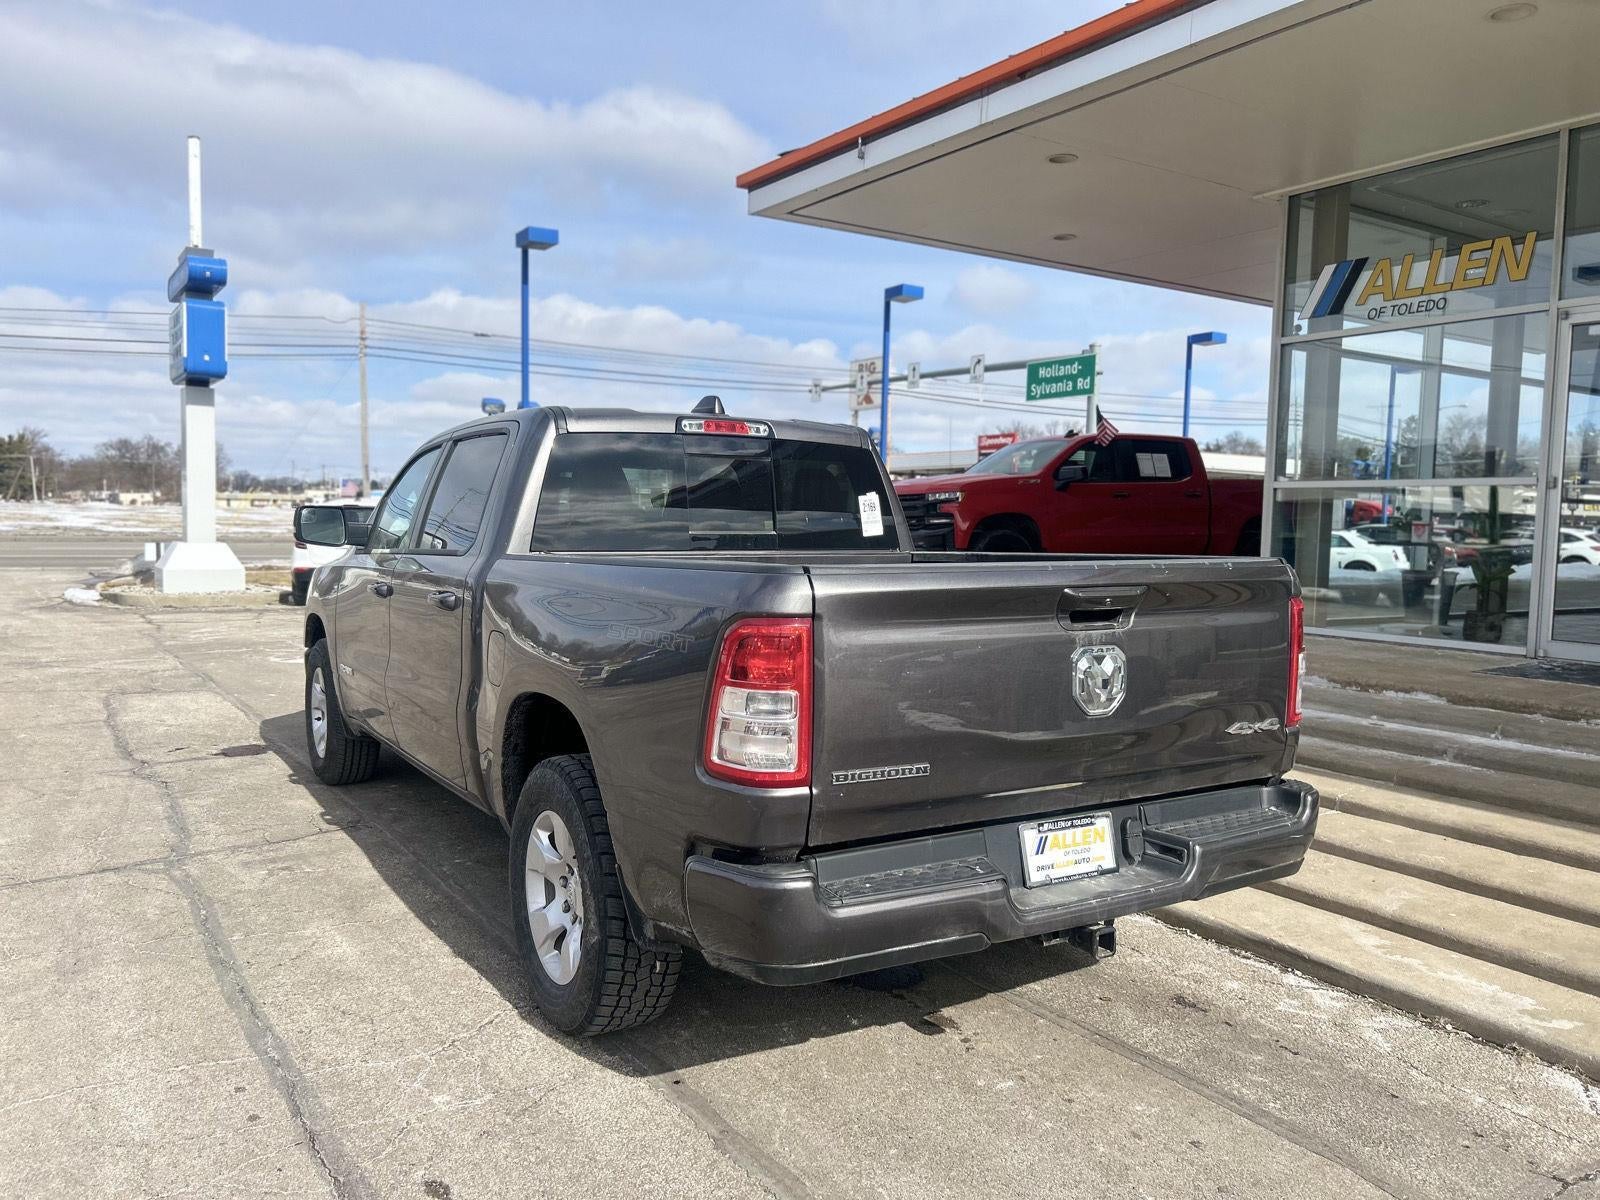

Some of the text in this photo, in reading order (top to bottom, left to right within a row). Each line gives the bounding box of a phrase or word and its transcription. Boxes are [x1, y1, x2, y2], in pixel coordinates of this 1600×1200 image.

[1355, 231, 1538, 306] ALLEN
[1367, 297, 1447, 320] OF TOLEDO
[1039, 361, 1082, 378] Holland-
[1030, 376, 1091, 398] Sylvania Rd
[607, 623, 695, 653] SPORT
[832, 763, 931, 785] BIGHORN
[1048, 821, 1066, 830] ALLEN
[1073, 818, 1092, 826] TOLEDO
[1049, 827, 1105, 849] ALLEN
[1072, 847, 1091, 855] TOLEDO
